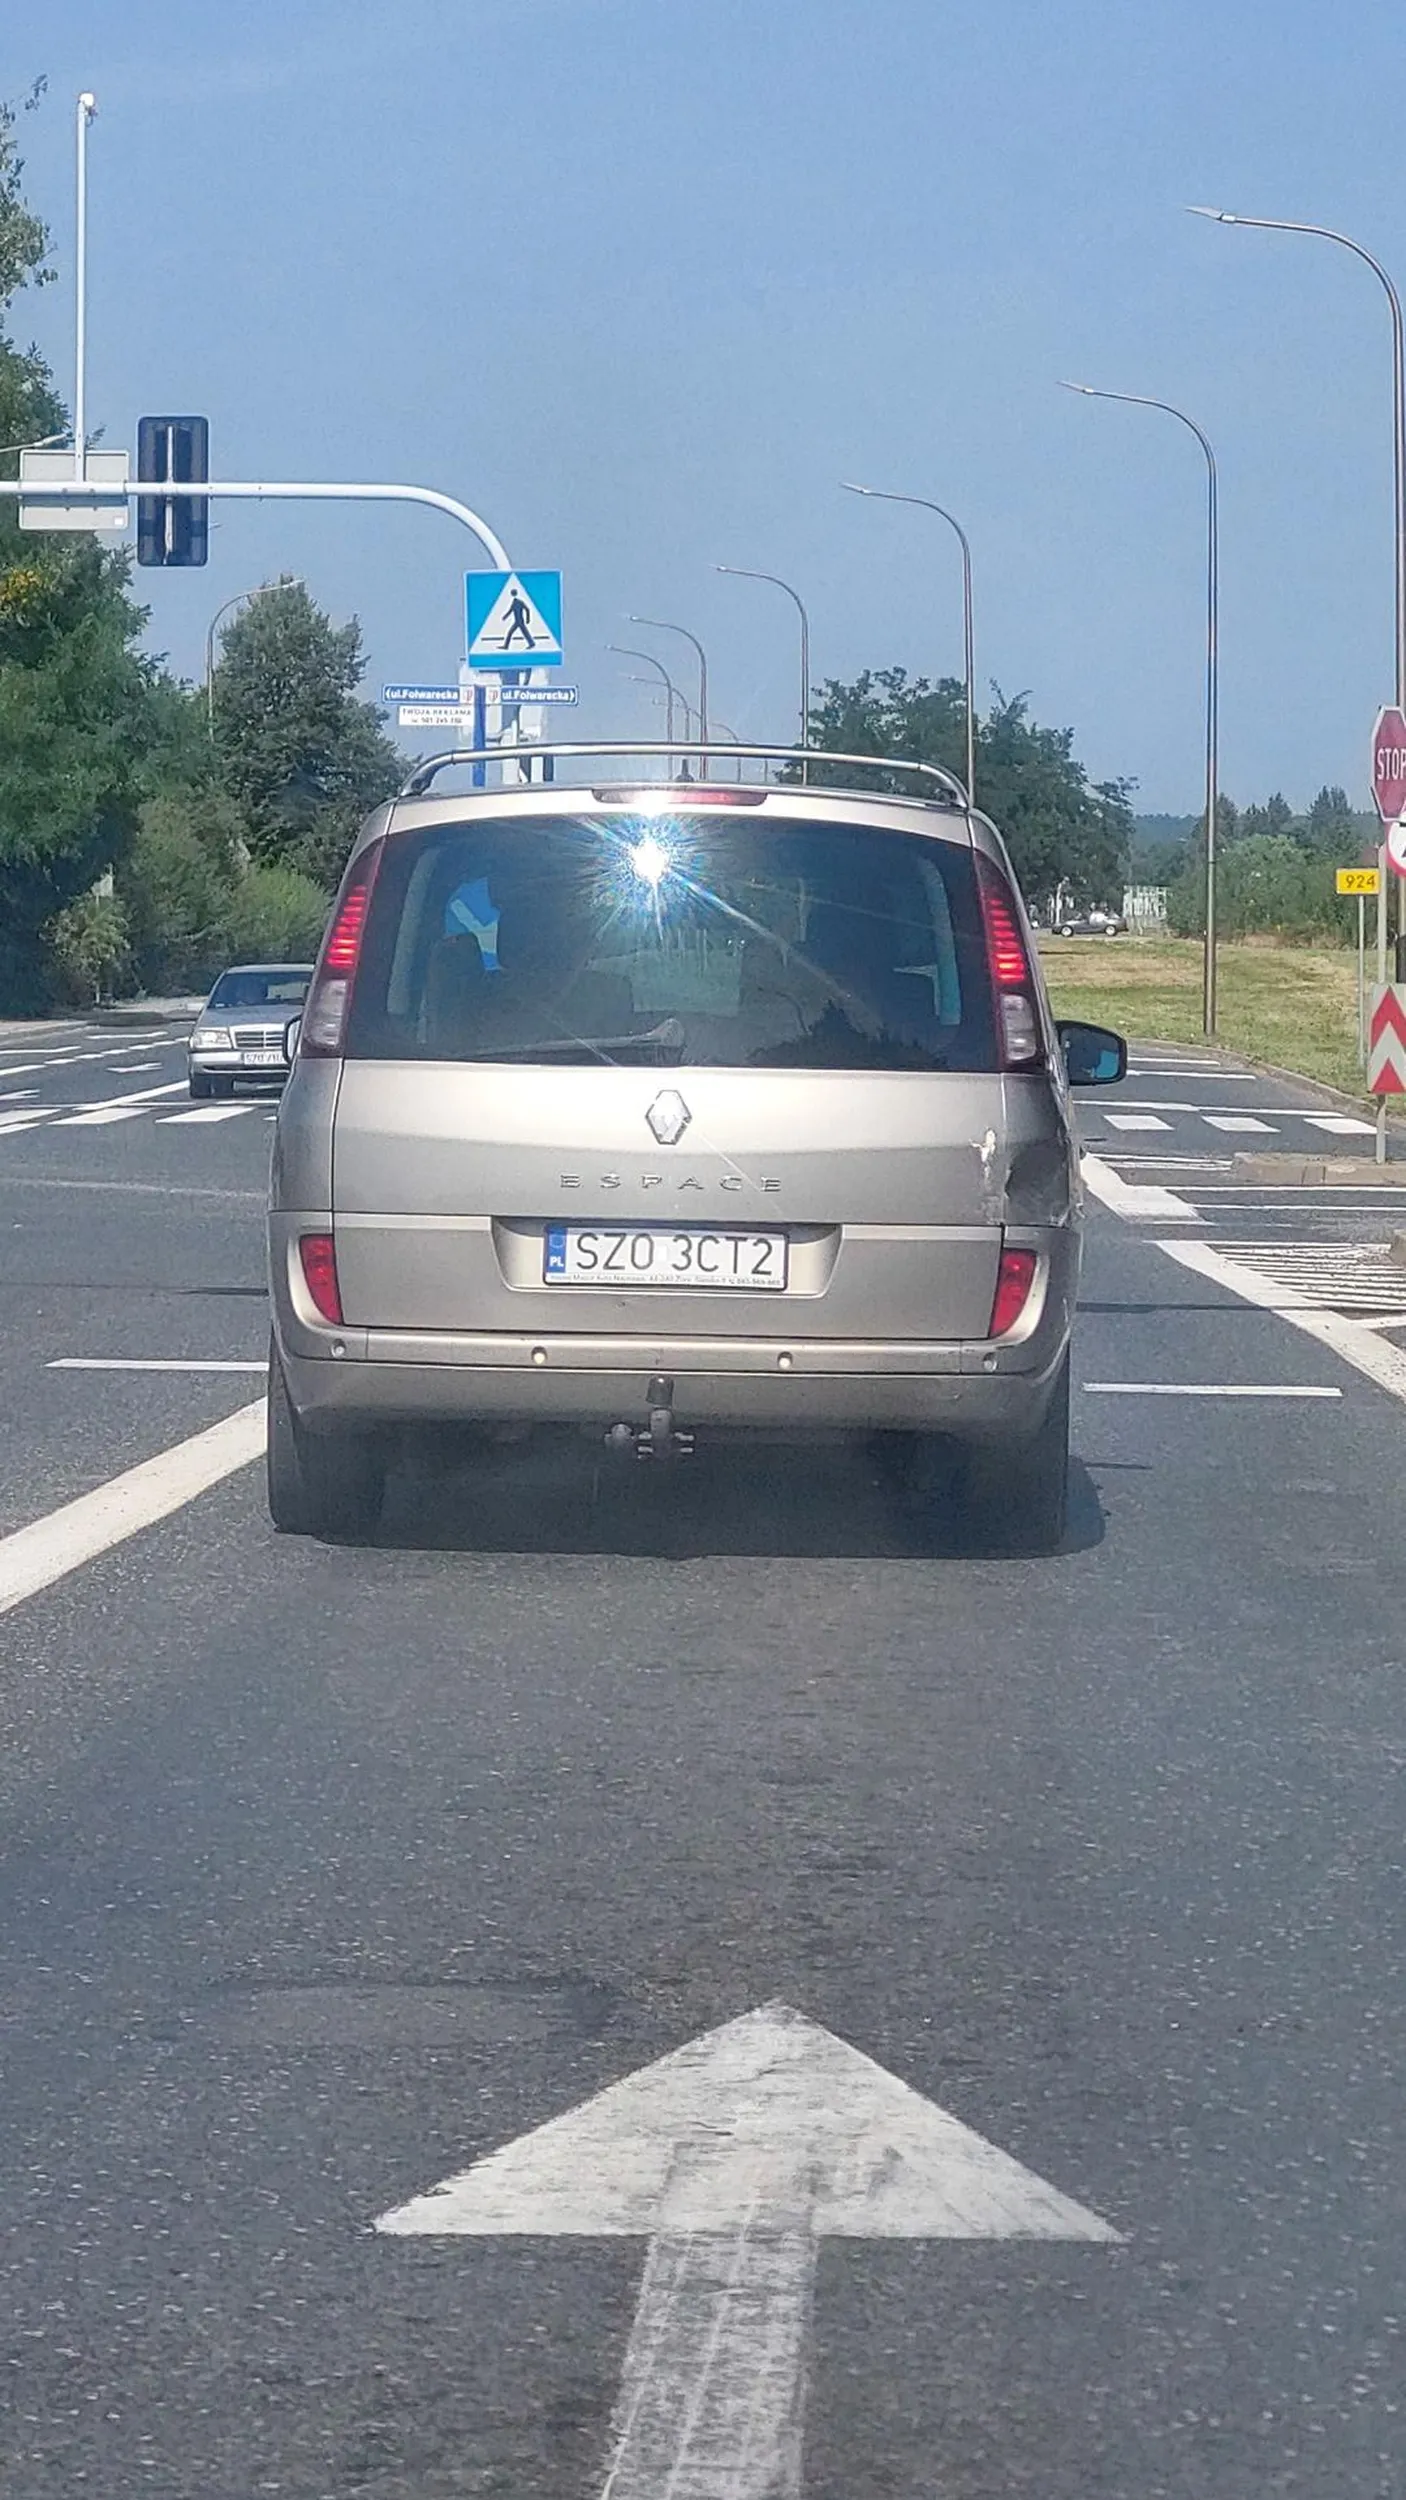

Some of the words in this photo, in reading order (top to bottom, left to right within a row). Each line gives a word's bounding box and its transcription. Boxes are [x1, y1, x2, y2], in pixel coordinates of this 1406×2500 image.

[1377, 747, 1406, 780] STOP
[1345, 874, 1376, 889] 924
[560, 1173, 782, 1193] ESPACE
[549, 1255, 565, 1268] PL
[671, 1233, 773, 1276] 3CT2
